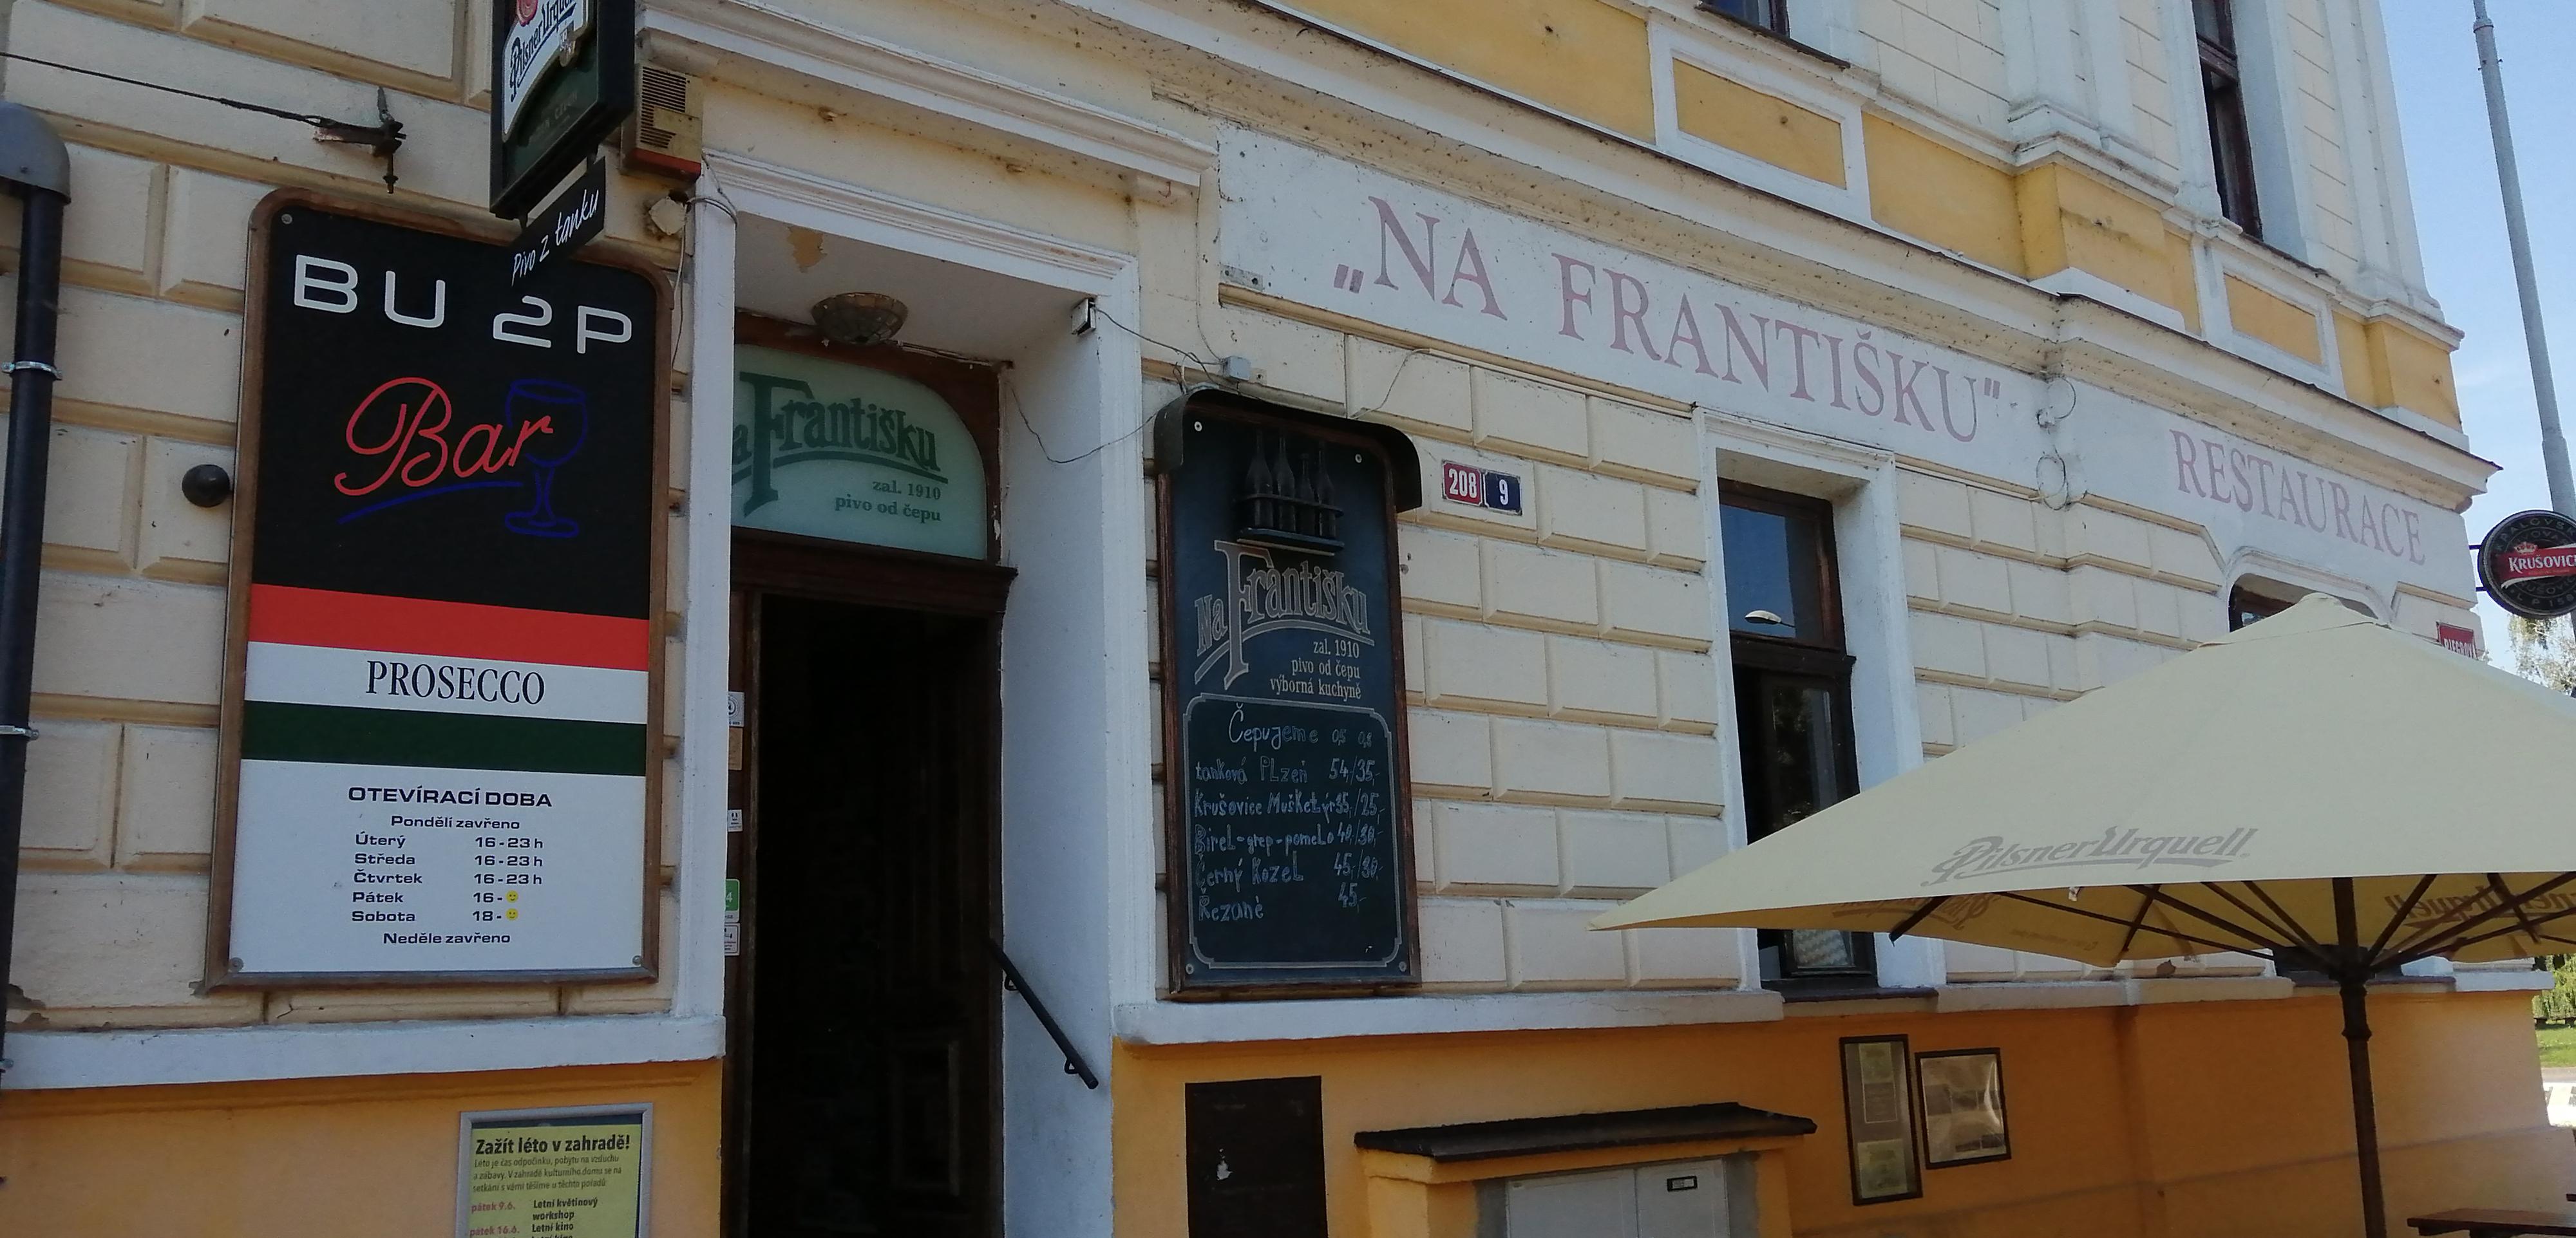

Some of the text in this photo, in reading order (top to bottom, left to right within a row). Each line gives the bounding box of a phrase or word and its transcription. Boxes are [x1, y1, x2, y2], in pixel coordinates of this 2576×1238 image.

[511, 250, 537, 286] Pivo
[555, 189, 599, 247] tanku
[334, 377, 554, 496] Bar
[739, 371, 941, 518] Františku
[872, 480, 942, 500] zal. 1910
[1448, 468, 1477, 498] 208
[1499, 478, 1509, 505] 9
[2169, 429, 2426, 566] RESTAURACE
[835, 494, 942, 524] pivo od čepu
[1195, 539, 1371, 691] Na Františku
[1313, 639, 1360, 659] zal. 1910
[1292, 657, 1361, 680] pivo od čepu
[365, 659, 545, 705] PROSECCO
[1270, 674, 1361, 702] výborná kuchyně
[1229, 702, 1319, 752] Čepujeme
[348, 785, 553, 808] OTEVÍRACÍ DOBA
[390, 814, 520, 830] Pondělí zavřeno
[355, 830, 406, 849] Úterý
[354, 852, 415, 865] Středa
[1920, 825, 2259, 887] Pilsner Urquell
[354, 868, 422, 885] Čtvrtek
[352, 890, 404, 903] Pátek
[352, 910, 415, 922] Sobota
[383, 932, 511, 944] Neděle zavřeno
[475, 1134, 630, 1154] Zažít léto v zahradě!
[471, 1201, 497, 1214] pátek
[533, 1197, 598, 1208] Letní květinový
[533, 1210, 574, 1221] workshop
[469, 1225, 495, 1238] pátek
[531, 1222, 574, 1233] Letní kino
